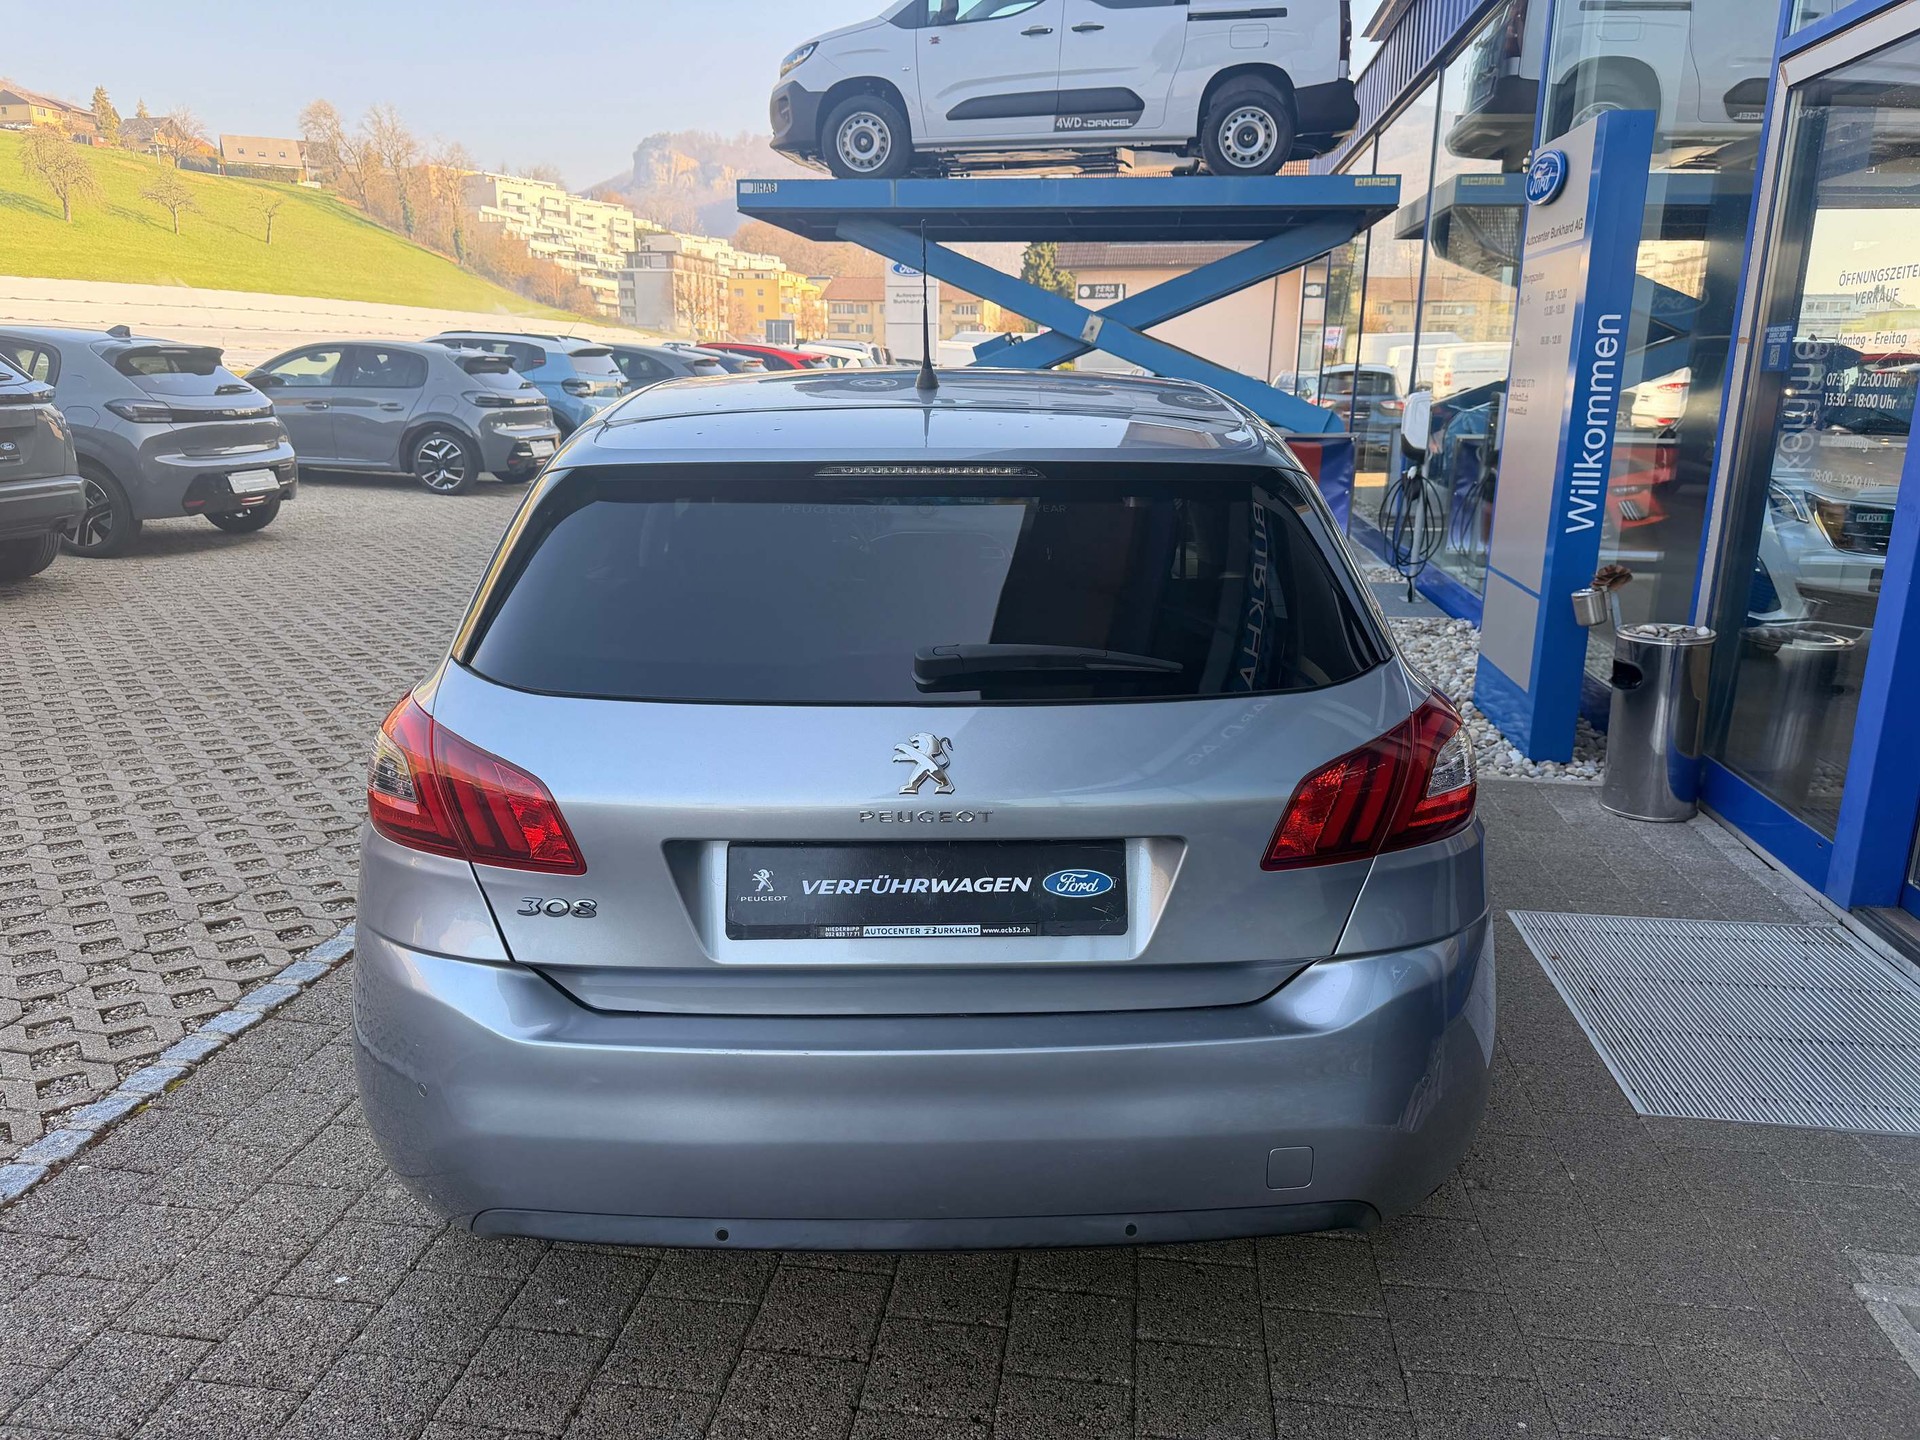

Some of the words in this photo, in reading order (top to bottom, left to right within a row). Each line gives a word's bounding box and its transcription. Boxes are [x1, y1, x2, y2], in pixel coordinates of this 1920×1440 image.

[1056, 117, 1081, 128] 4WD
[1087, 119, 1133, 128] DANGEL
[1551, 220, 1574, 239] Burkhard
[1574, 218, 1584, 230] AG
[1839, 264, 1920, 287] ÖFFNUNGSZEITE
[1855, 288, 1900, 305] VERKAUF
[1833, 333, 1866, 349] Montag
[1874, 331, 1908, 348] Freitag
[1826, 373, 1850, 386] 07:30
[1857, 373, 1882, 387] 12:00
[1883, 373, 1901, 388] Uhr
[1824, 392, 1847, 407] 13:30
[1854, 393, 1878, 408] 18:00
[1880, 394, 1898, 410] Uhr
[1565, 314, 1622, 534] Willkommen
[1811, 469, 1833, 483] 09:00
[1841, 473, 1862, 487] 12:00
[859, 810, 993, 823] PEUGEOT
[801, 874, 1032, 895] VERFÜHRWAGEN
[1056, 873, 1099, 892] Ford
[517, 897, 597, 918] 308
[864, 927, 921, 935] AUTOCENTER
[924, 926, 980, 934] BURKHARD
